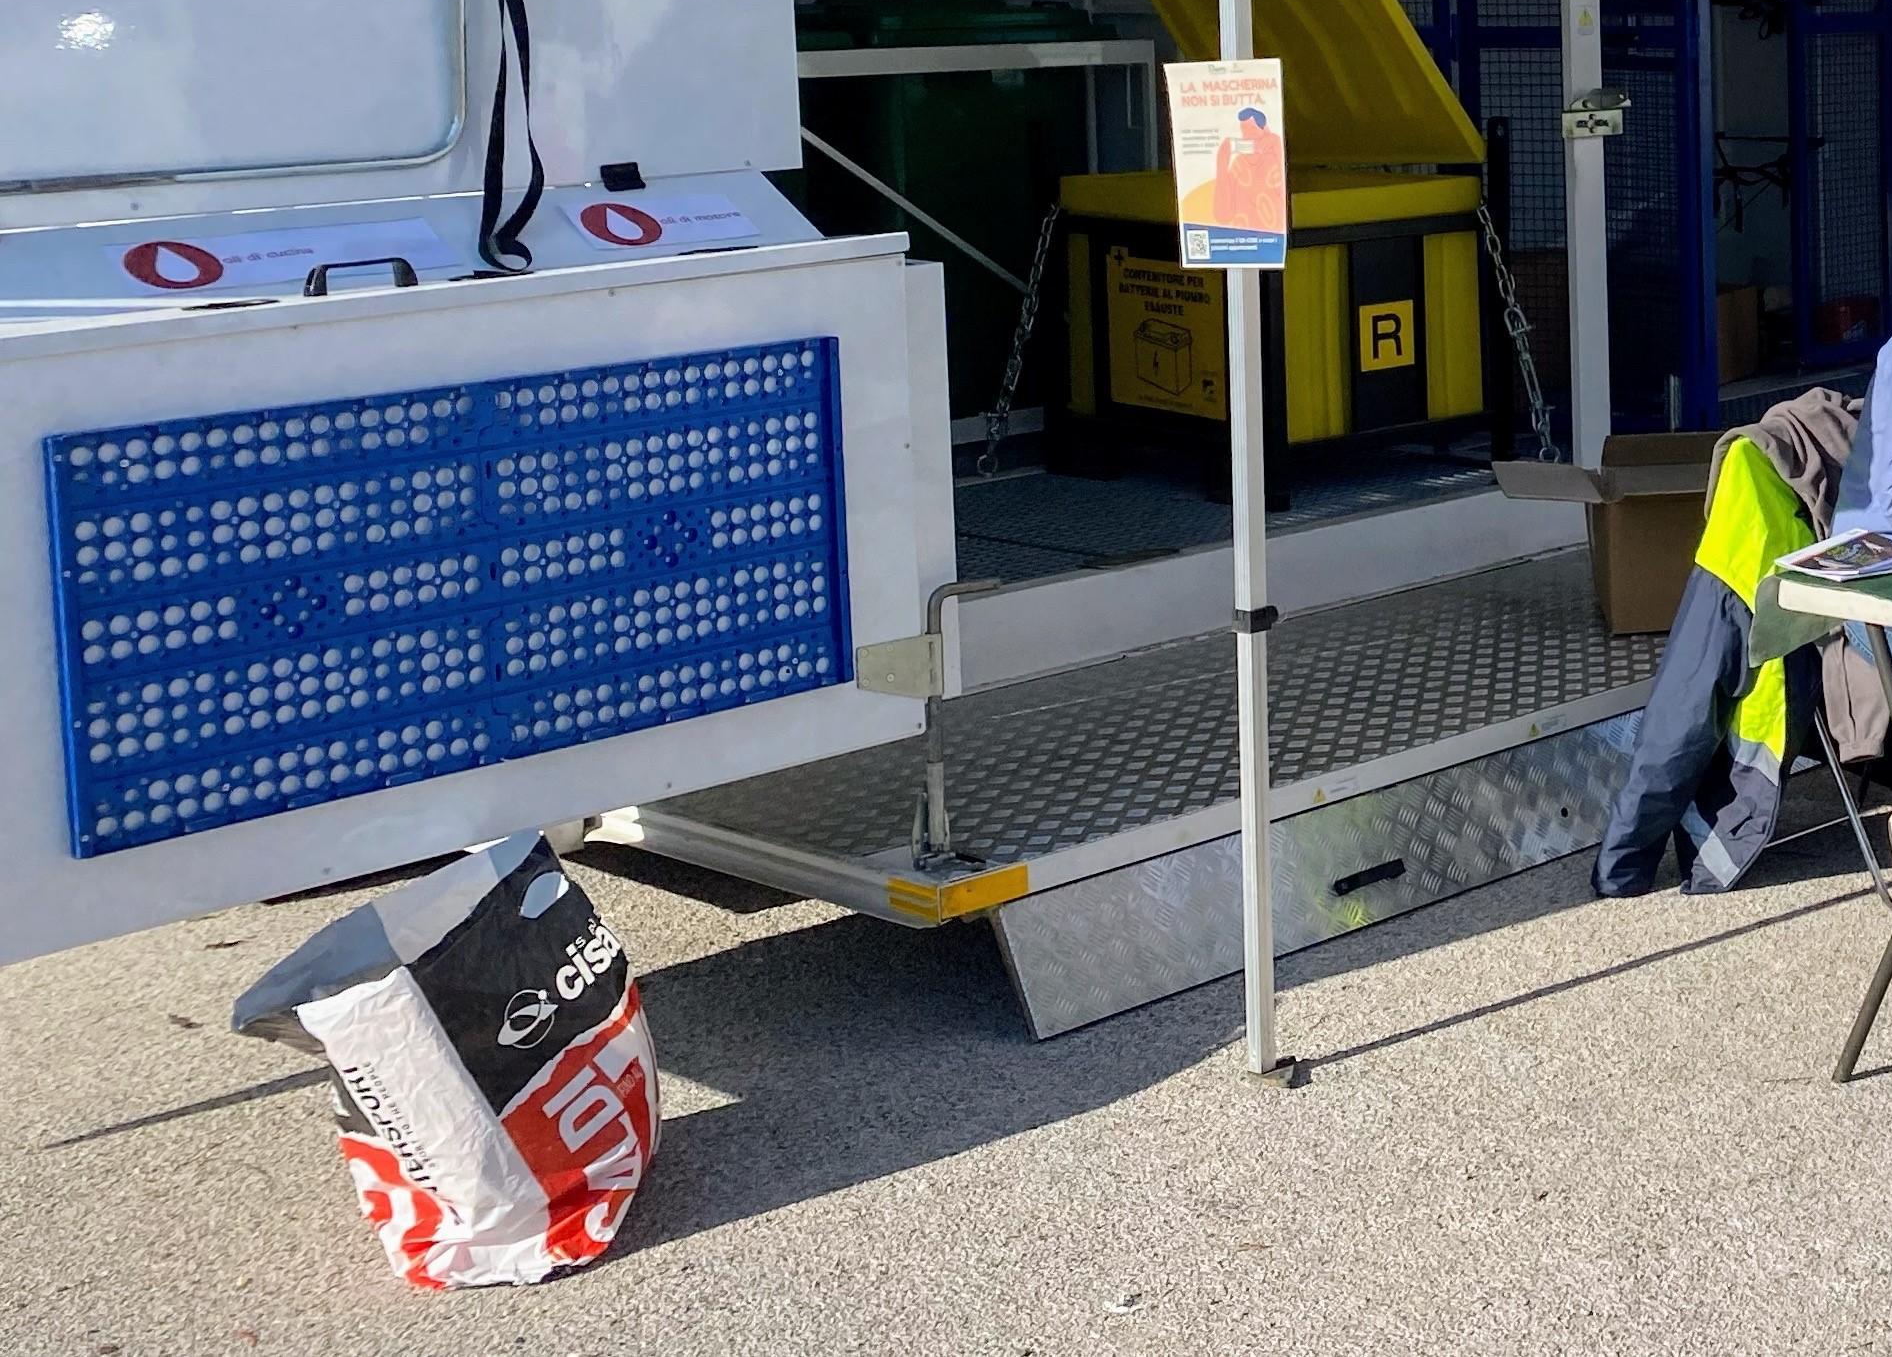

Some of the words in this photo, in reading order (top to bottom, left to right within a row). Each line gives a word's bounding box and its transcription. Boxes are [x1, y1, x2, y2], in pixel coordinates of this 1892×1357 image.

[1179, 80, 1197, 94] LA
[1201, 77, 1279, 92] MASCHERINA
[1180, 95, 1208, 108] NON
[1210, 94, 1221, 107] SI
[1371, 313, 1403, 360] R
